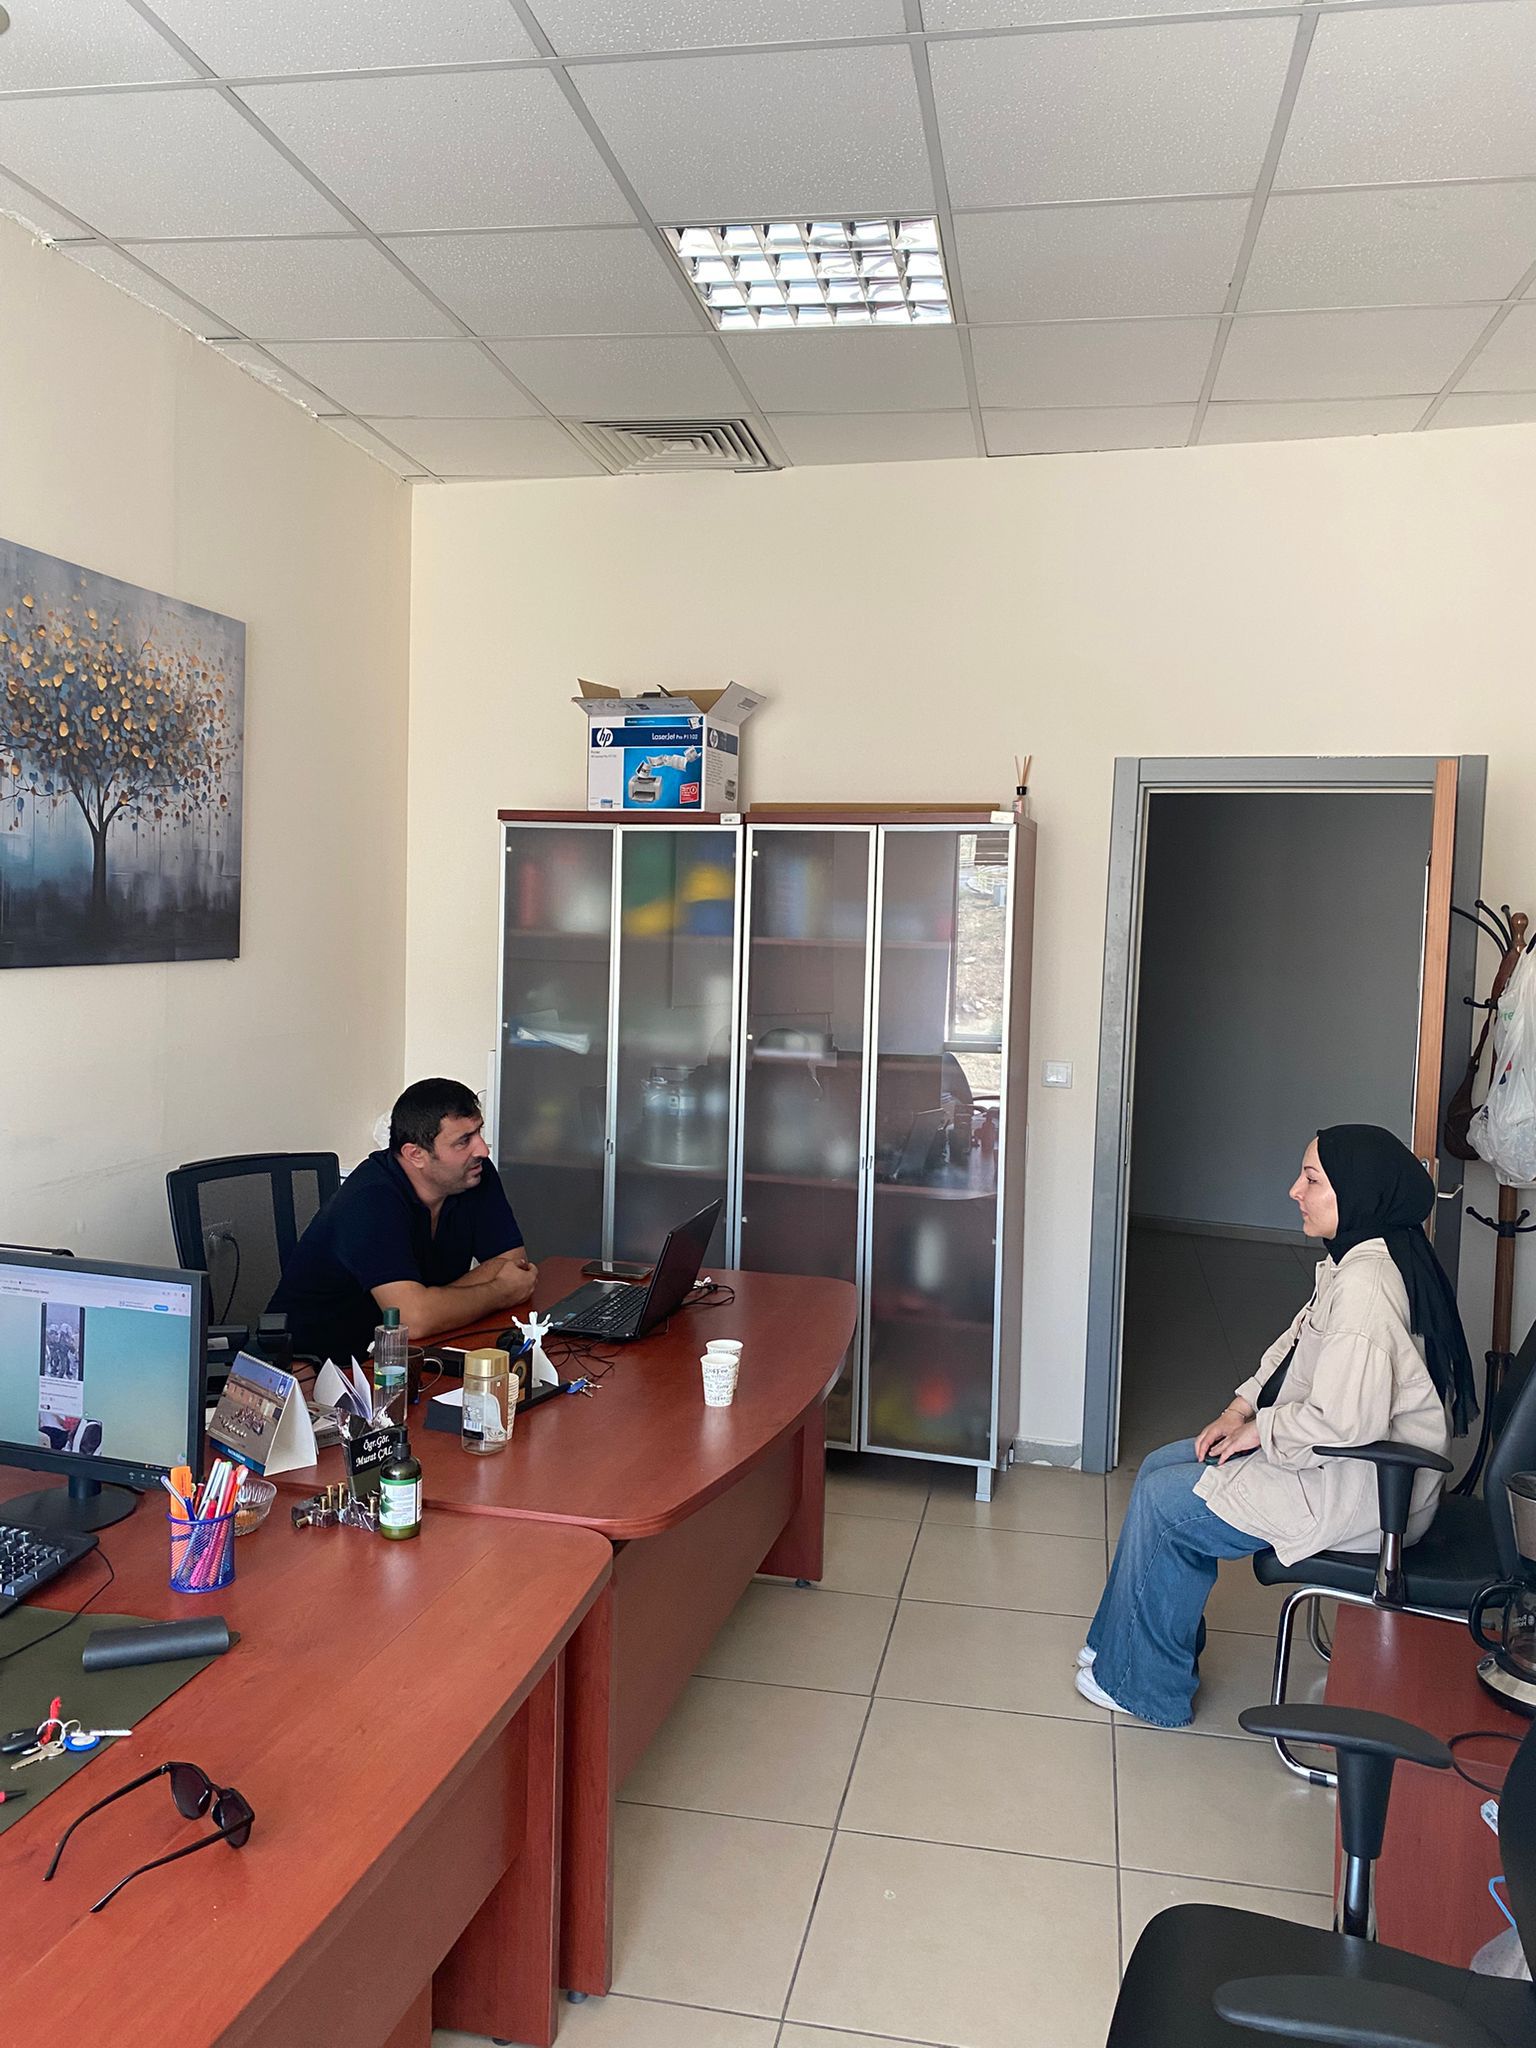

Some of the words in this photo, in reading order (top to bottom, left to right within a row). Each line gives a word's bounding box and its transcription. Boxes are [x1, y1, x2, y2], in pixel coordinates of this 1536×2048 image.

[598, 728, 613, 747] hp
[652, 732, 675, 740] LaserJet
[356, 1453, 377, 1467] Murat
